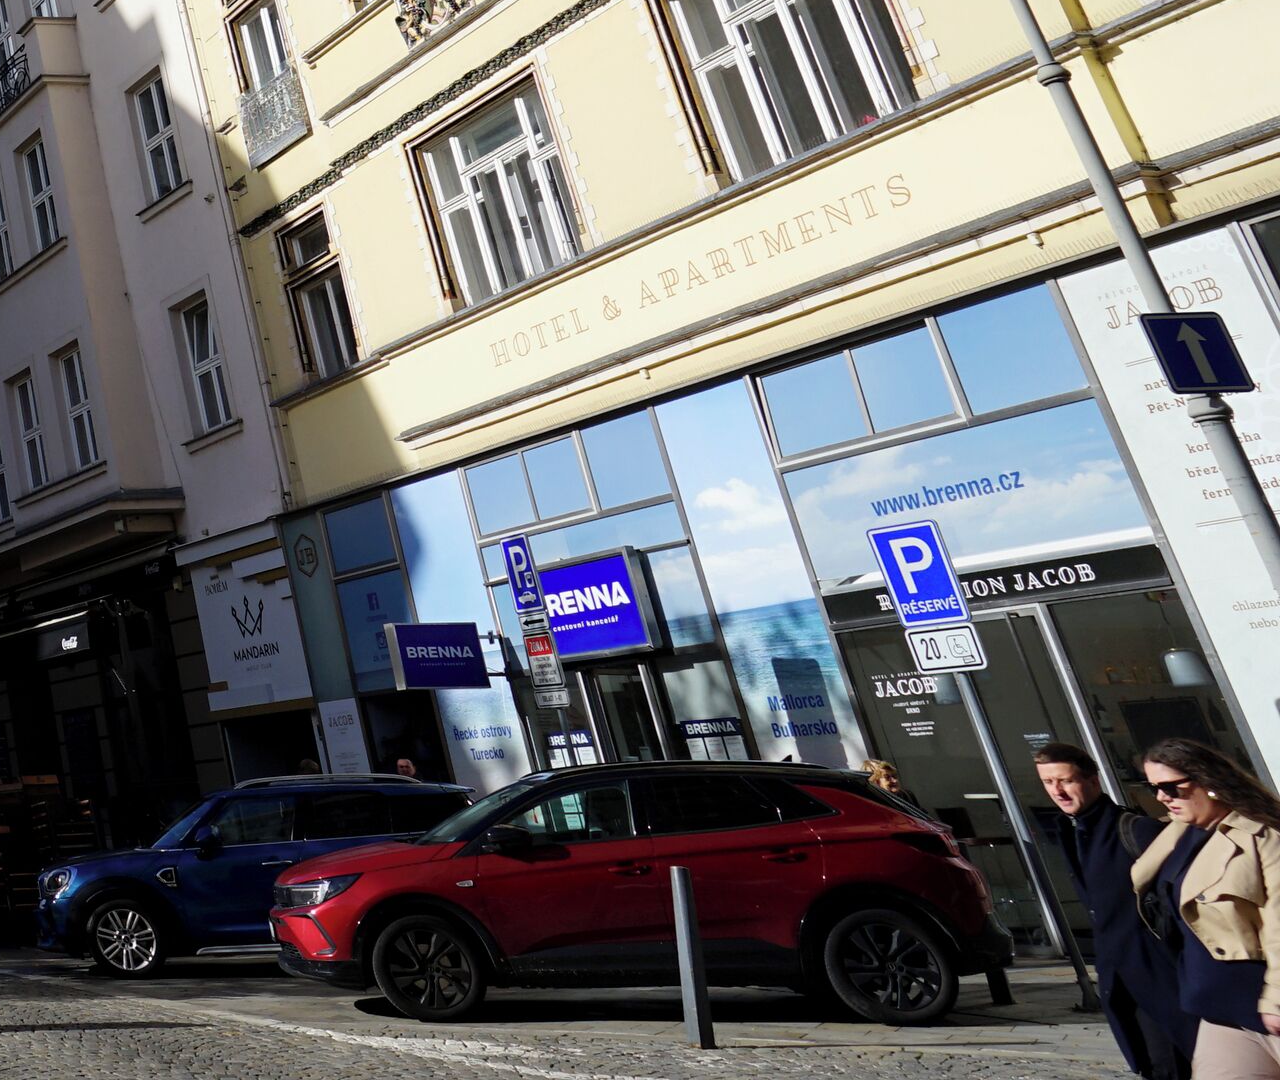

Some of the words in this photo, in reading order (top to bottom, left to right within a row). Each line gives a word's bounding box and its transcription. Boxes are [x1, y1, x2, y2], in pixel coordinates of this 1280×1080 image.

[489, 308, 591, 368] HOTEL
[602, 295, 622, 322] &
[639, 172, 913, 310] APARTMENTS
[1105, 277, 1223, 330] JAOB
[870, 470, 1025, 518] www.brenna.cz
[297, 546, 315, 566] JB
[888, 536, 935, 595] P
[508, 545, 527, 589] P
[1013, 563, 1097, 592] JACOB
[544, 581, 631, 617] RENNA
[900, 594, 960, 616] RÉSERVÉ
[552, 620, 585, 633] cestovní
[586, 614, 619, 628] kancelář
[1249, 617, 1279, 629] nebo
[233, 641, 280, 662] MANDARIN
[405, 645, 475, 659] BRENNA
[874, 677, 938, 698] JACOB
[767, 694, 825, 712] Mallorca
[453, 725, 479, 741] Řecké
[480, 725, 513, 739] ostrovy
[686, 720, 737, 735] BRENNA
[771, 719, 838, 738] Bulharsko
[470, 747, 505, 761] Turecko
